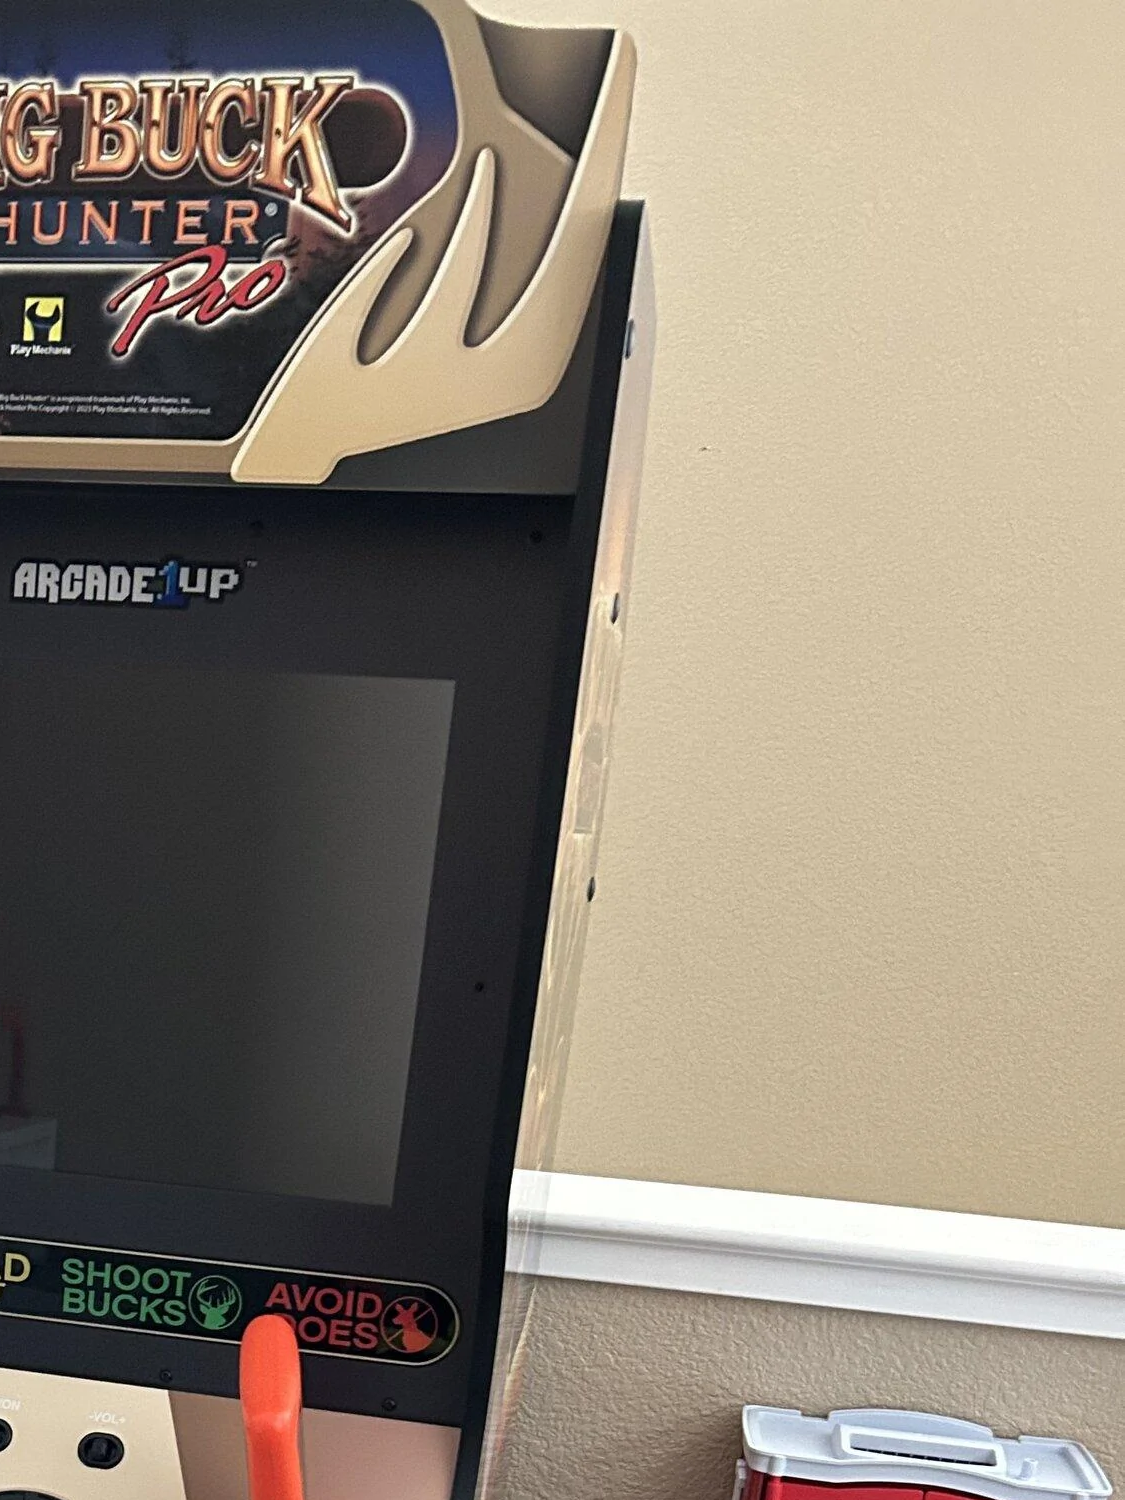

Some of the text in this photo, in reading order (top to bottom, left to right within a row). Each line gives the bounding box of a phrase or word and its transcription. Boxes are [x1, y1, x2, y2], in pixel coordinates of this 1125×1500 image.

[73, 75, 353, 233] BUCK
[106, 244, 286, 357] Pro
[61, 1258, 191, 1297] SHOOT
[62, 1287, 187, 1326] BUCKS
[265, 1282, 383, 1319] AVOID
[275, 1312, 379, 1350] OES
